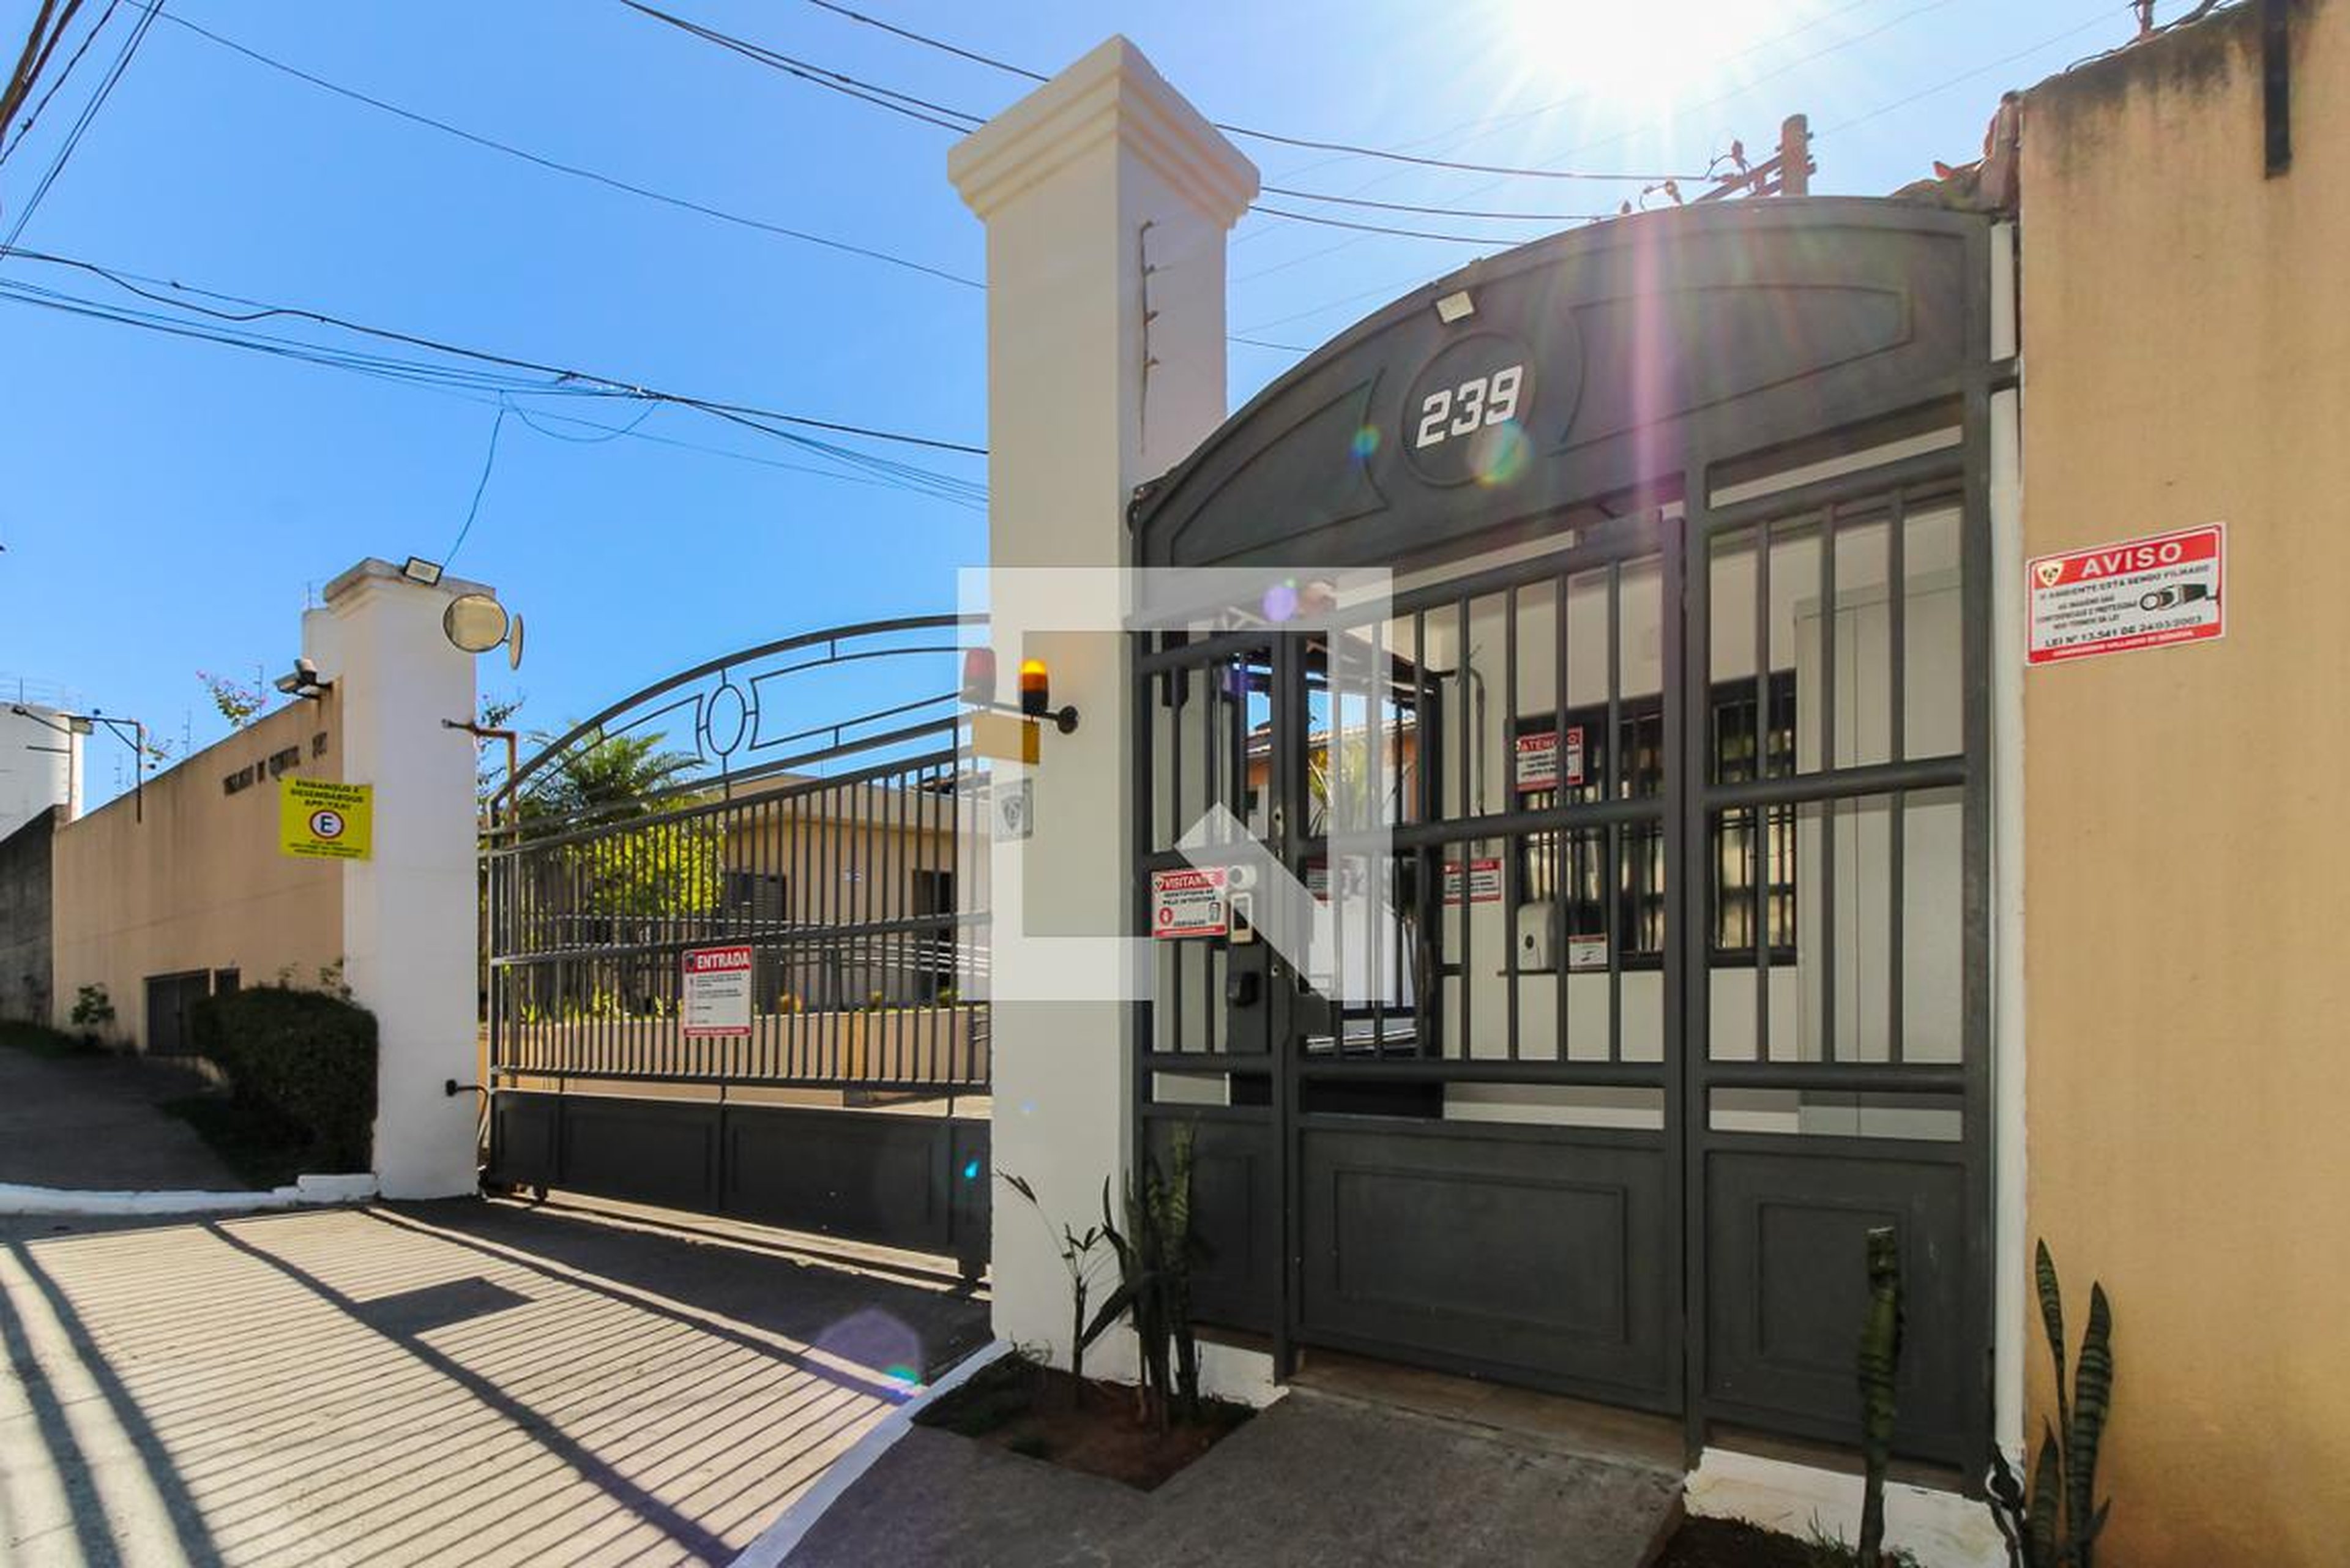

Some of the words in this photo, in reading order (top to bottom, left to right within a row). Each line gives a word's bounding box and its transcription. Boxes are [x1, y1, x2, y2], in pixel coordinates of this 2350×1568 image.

[1416, 365, 1523, 447] 239
[2081, 543, 2182, 578] AVISO
[2049, 584, 2098, 598] AMBIENTE
[2128, 573, 2161, 586] SENDO
[2163, 564, 2210, 579] FILMADO
[2045, 637, 2064, 648] LEI
[2121, 625, 2136, 635] DE
[296, 779, 351, 793] EMBARQUE
[291, 788, 364, 803] DESEMBARQUE
[320, 815, 334, 833] E
[1163, 875, 1217, 889] VISITANTE
[697, 951, 750, 969] ENTRADA
